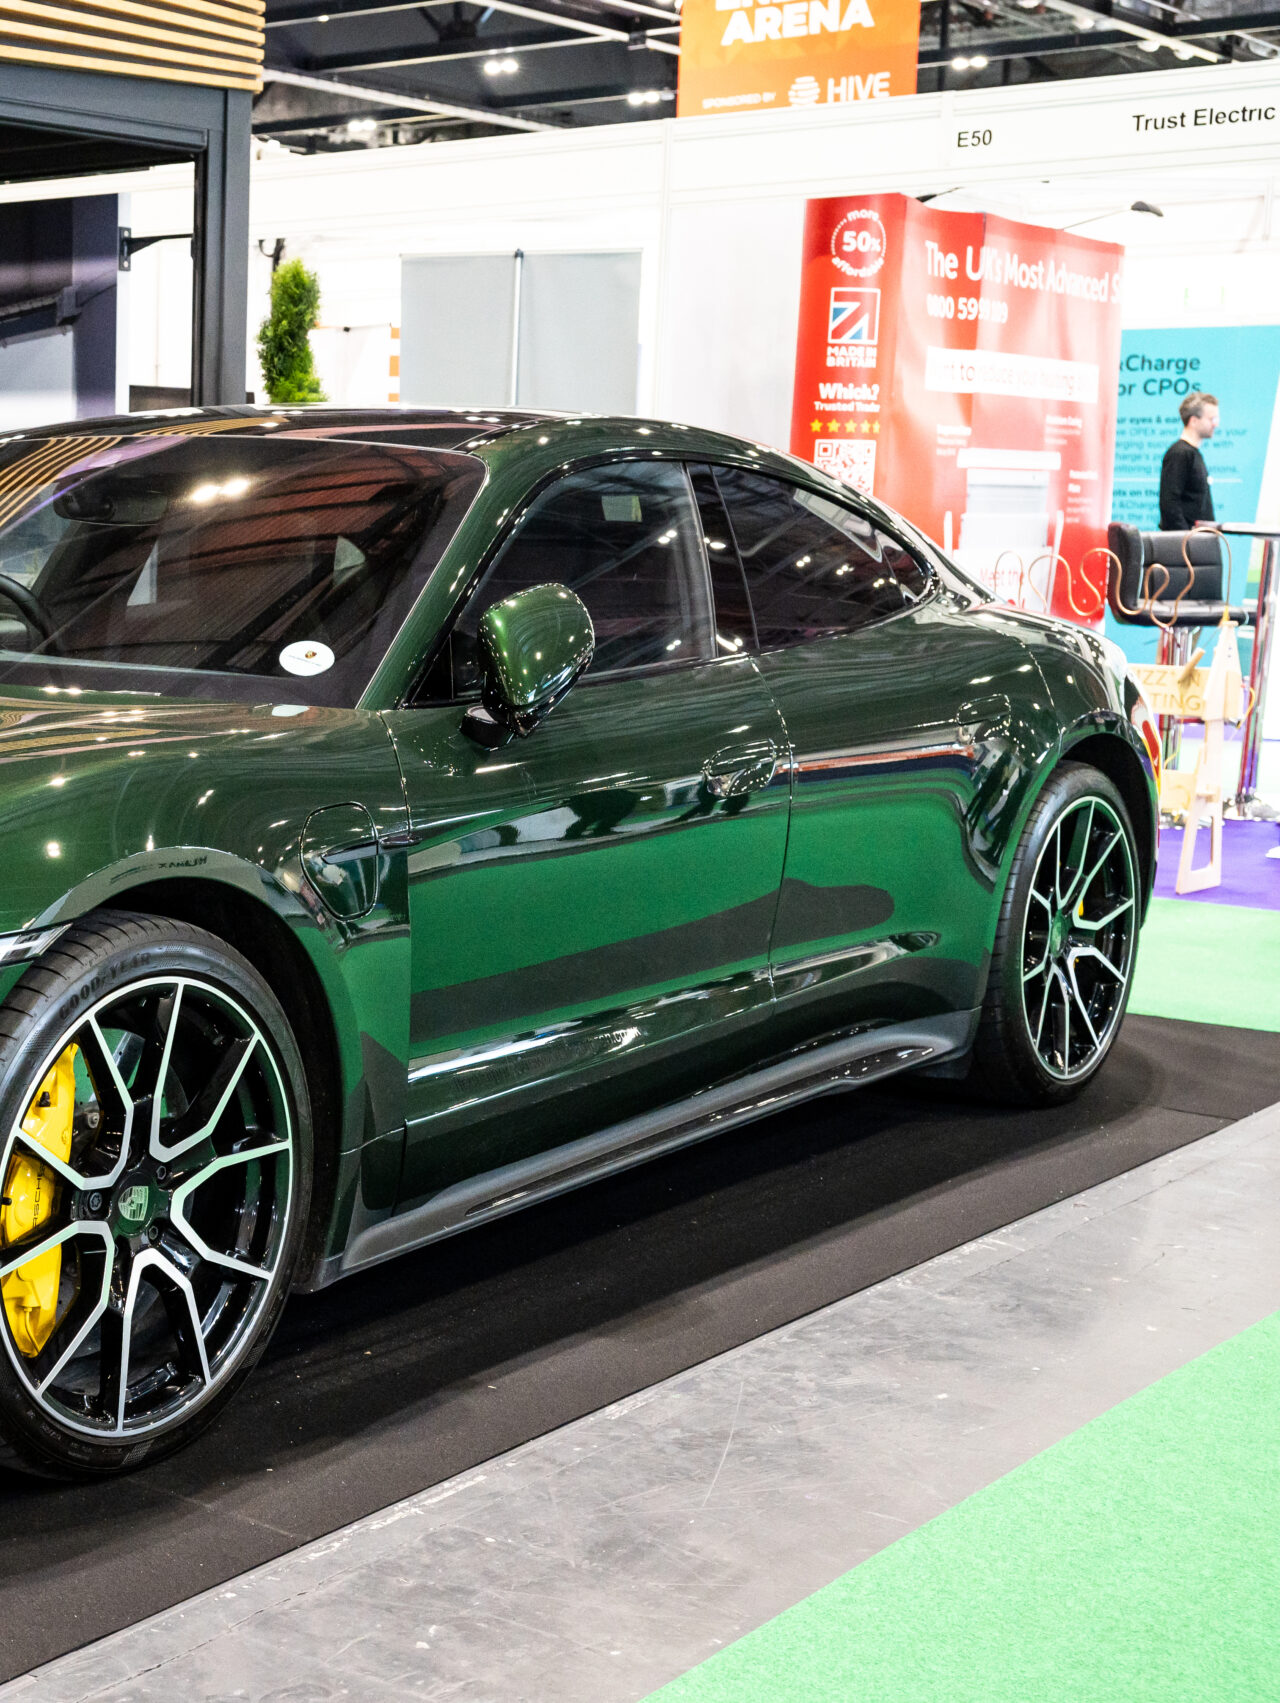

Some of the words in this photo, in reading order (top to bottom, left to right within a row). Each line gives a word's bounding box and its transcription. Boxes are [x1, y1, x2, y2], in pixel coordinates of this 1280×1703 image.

[720, 0, 876, 46] ARENA
[827, 72, 891, 103] HIVE
[1132, 111, 1186, 132] Trust
[1193, 106, 1276, 127] Electric
[957, 129, 992, 148] E50
[925, 239, 959, 280] The
[1003, 251, 1045, 290] Most
[826, 346, 864, 357] MADE
[826, 356, 877, 368] BRITAIN
[818, 382, 880, 401] Which?
[1118, 382, 1137, 396] or
[1143, 377, 1202, 396] CPOs
